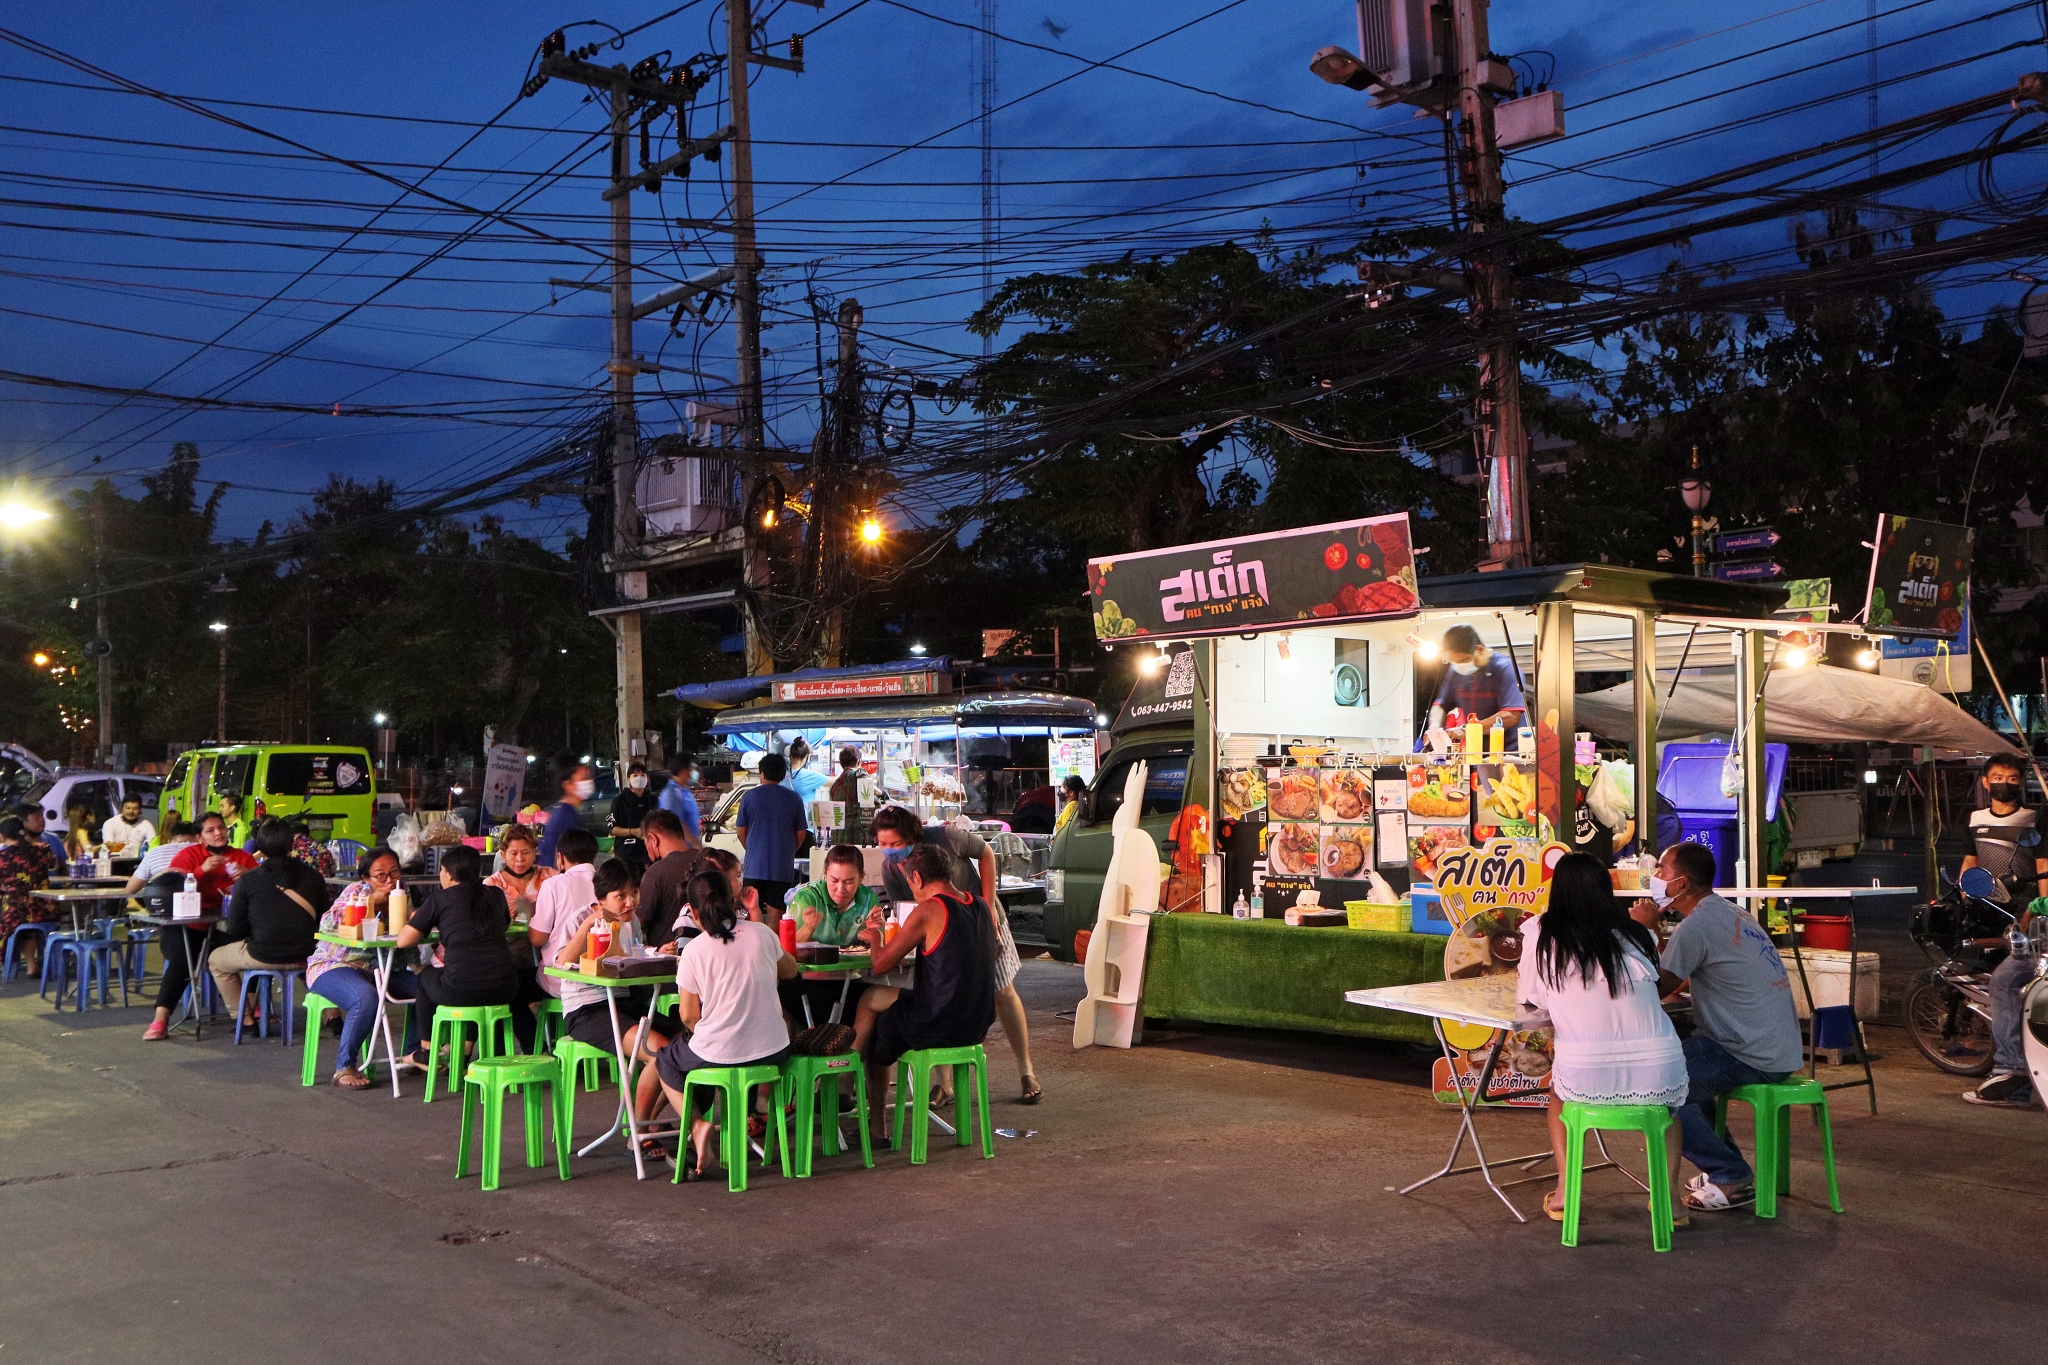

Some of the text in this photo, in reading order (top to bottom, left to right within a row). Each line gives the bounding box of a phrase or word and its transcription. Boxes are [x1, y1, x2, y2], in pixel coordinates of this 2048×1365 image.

[1159, 549, 1270, 623] สเต็ก
[1136, 699, 1193, 716] 063-447-9542
[1438, 844, 1525, 888] สเต็ก
